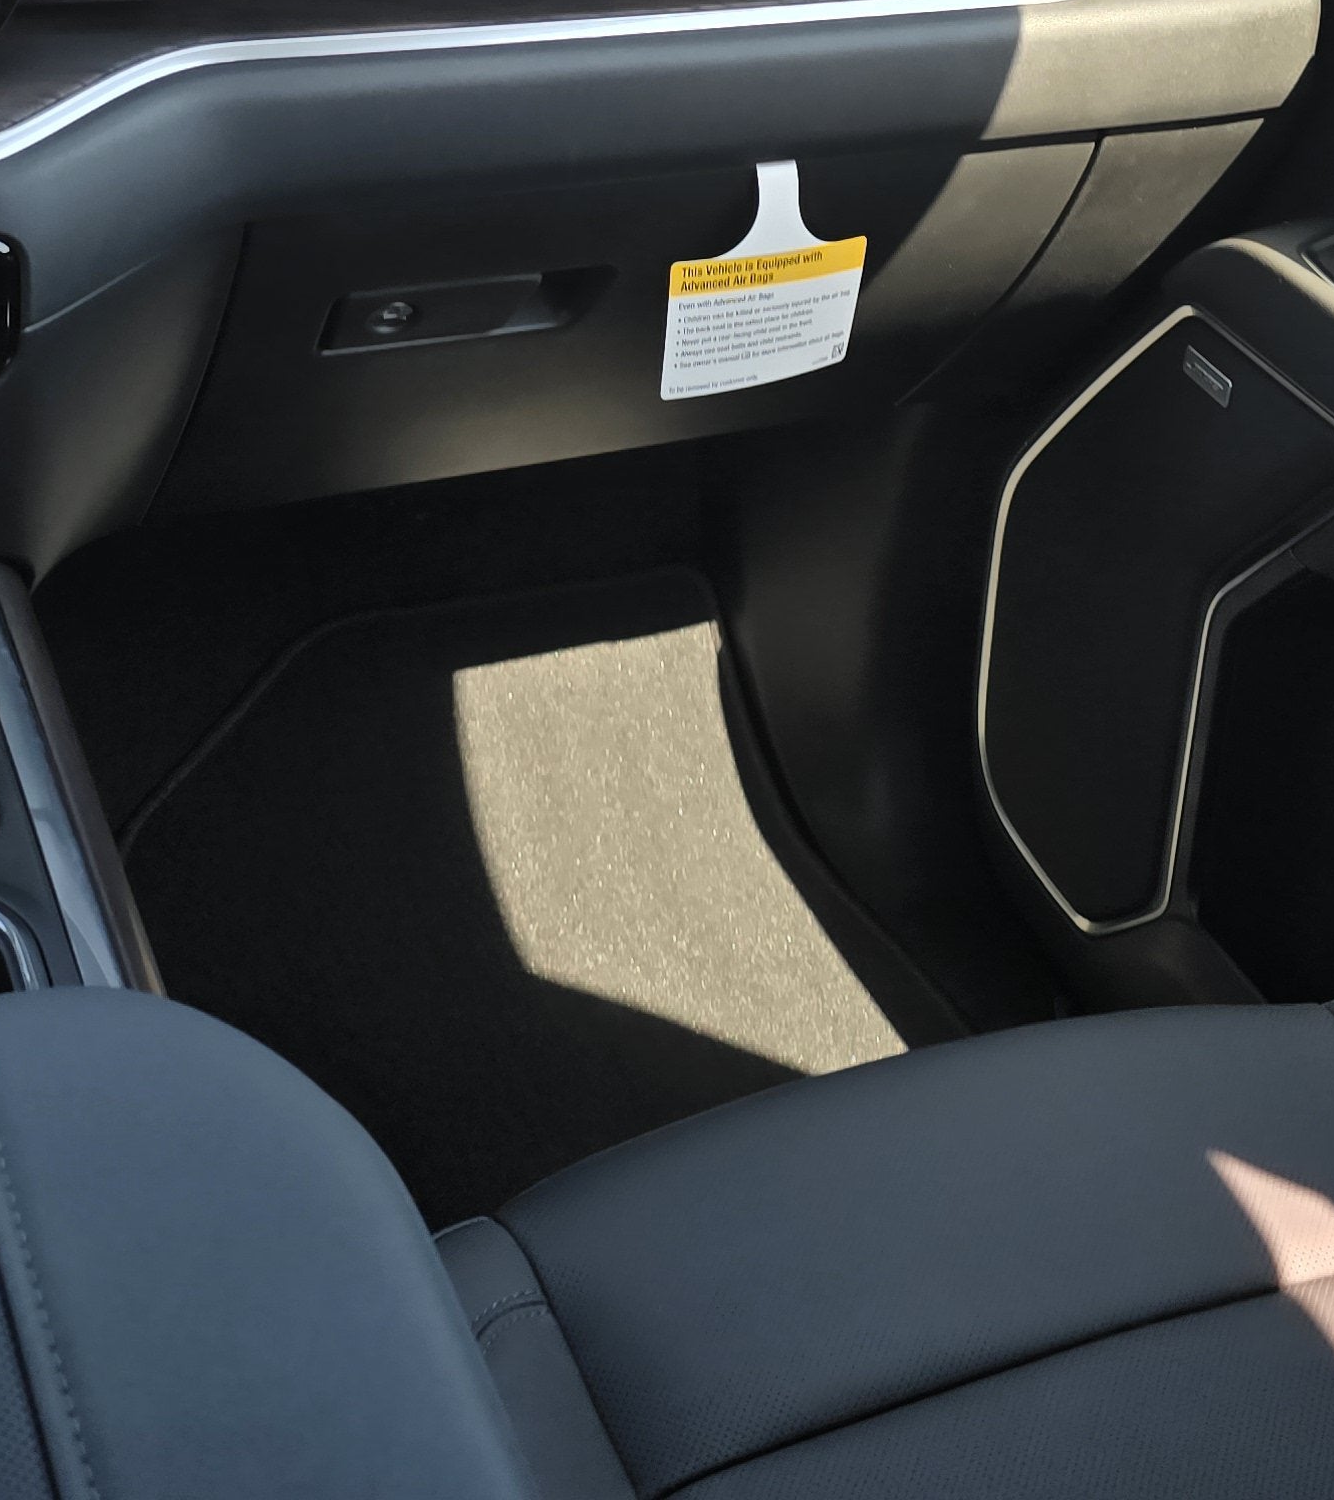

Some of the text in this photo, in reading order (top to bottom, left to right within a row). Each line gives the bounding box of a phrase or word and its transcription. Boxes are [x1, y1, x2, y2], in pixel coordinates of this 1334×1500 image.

[682, 251, 822, 278] This Vehicle is Equipped with
[680, 273, 774, 292] Advanced Air Bags
